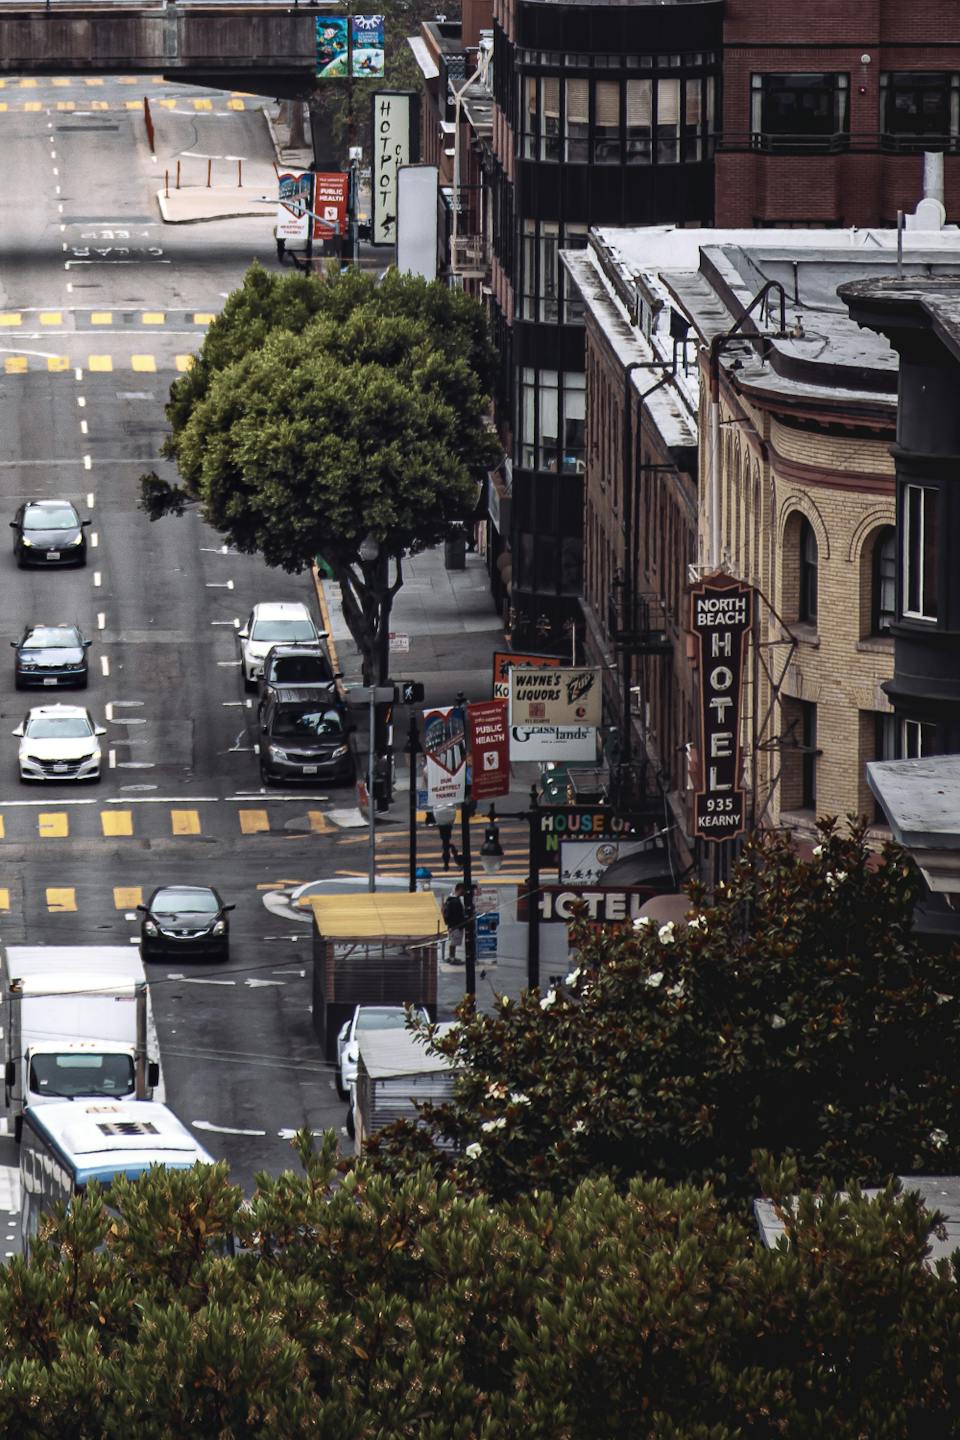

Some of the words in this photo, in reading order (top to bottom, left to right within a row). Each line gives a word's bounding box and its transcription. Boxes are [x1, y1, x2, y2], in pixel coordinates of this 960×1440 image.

[697, 598, 746, 612] NORTH
[697, 612, 746, 626] BEACH
[516, 672, 561, 687] WAYNE'S
[516, 690, 561, 701] LIQUORS
[709, 633, 734, 791] HOTEL
[475, 723, 503, 734] PUBLIC
[475, 734, 505, 745] HEALTH
[707, 798, 733, 811] 935
[541, 814, 605, 832] HOUSE
[698, 814, 740, 828] KEARNY
